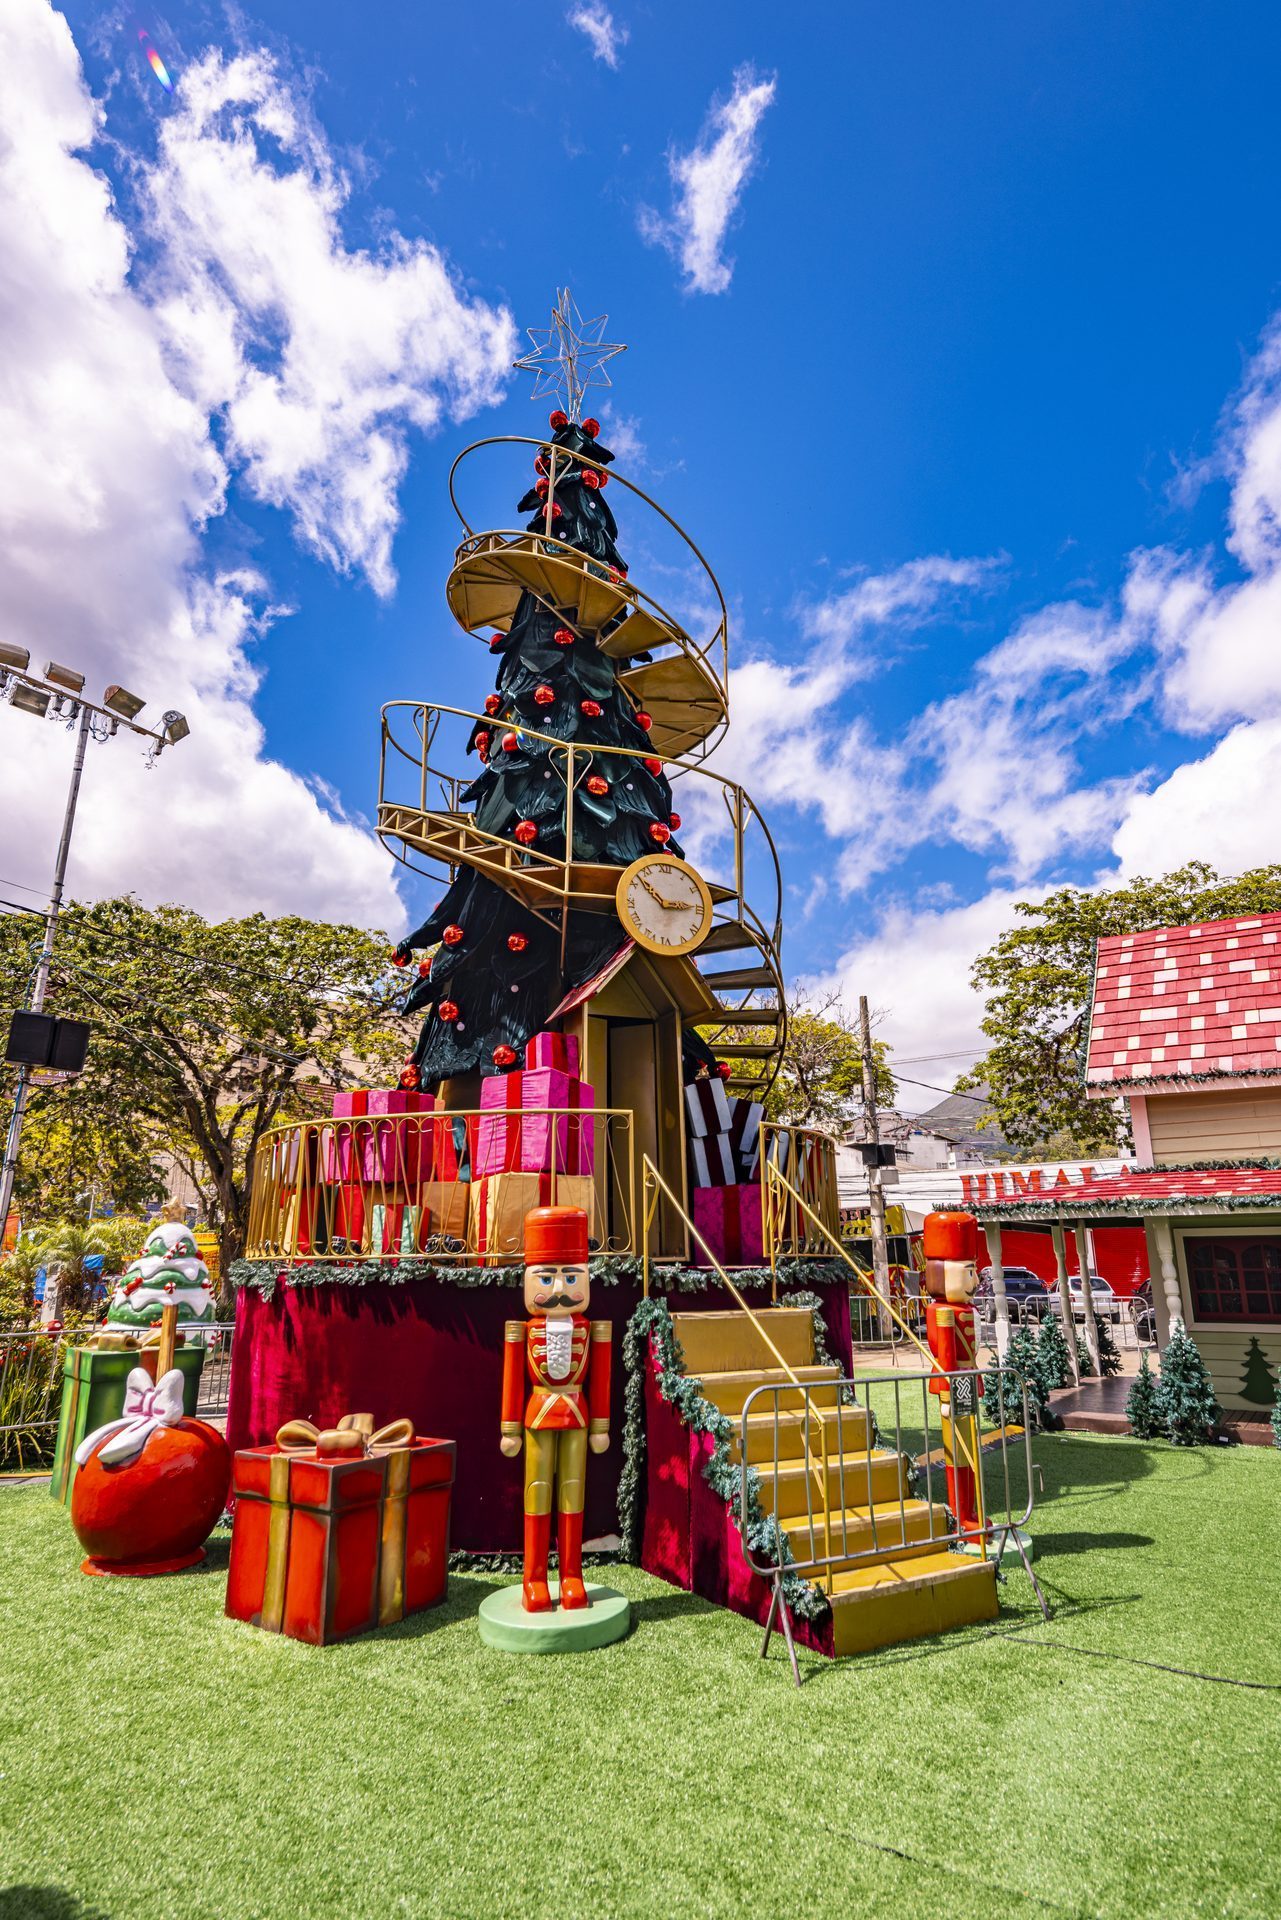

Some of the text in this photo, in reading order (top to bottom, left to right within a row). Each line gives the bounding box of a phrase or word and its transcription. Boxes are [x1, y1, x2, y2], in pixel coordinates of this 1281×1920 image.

[641, 866, 653, 877] XI
[659, 864, 672, 874] XII
[630, 880, 638, 889] X
[689, 886, 698, 894] II
[695, 904, 704, 916] III
[631, 911, 642, 929] VIII
[644, 927, 656, 941] VII
[660, 937, 672, 946] VI
[680, 935, 688, 944] V
